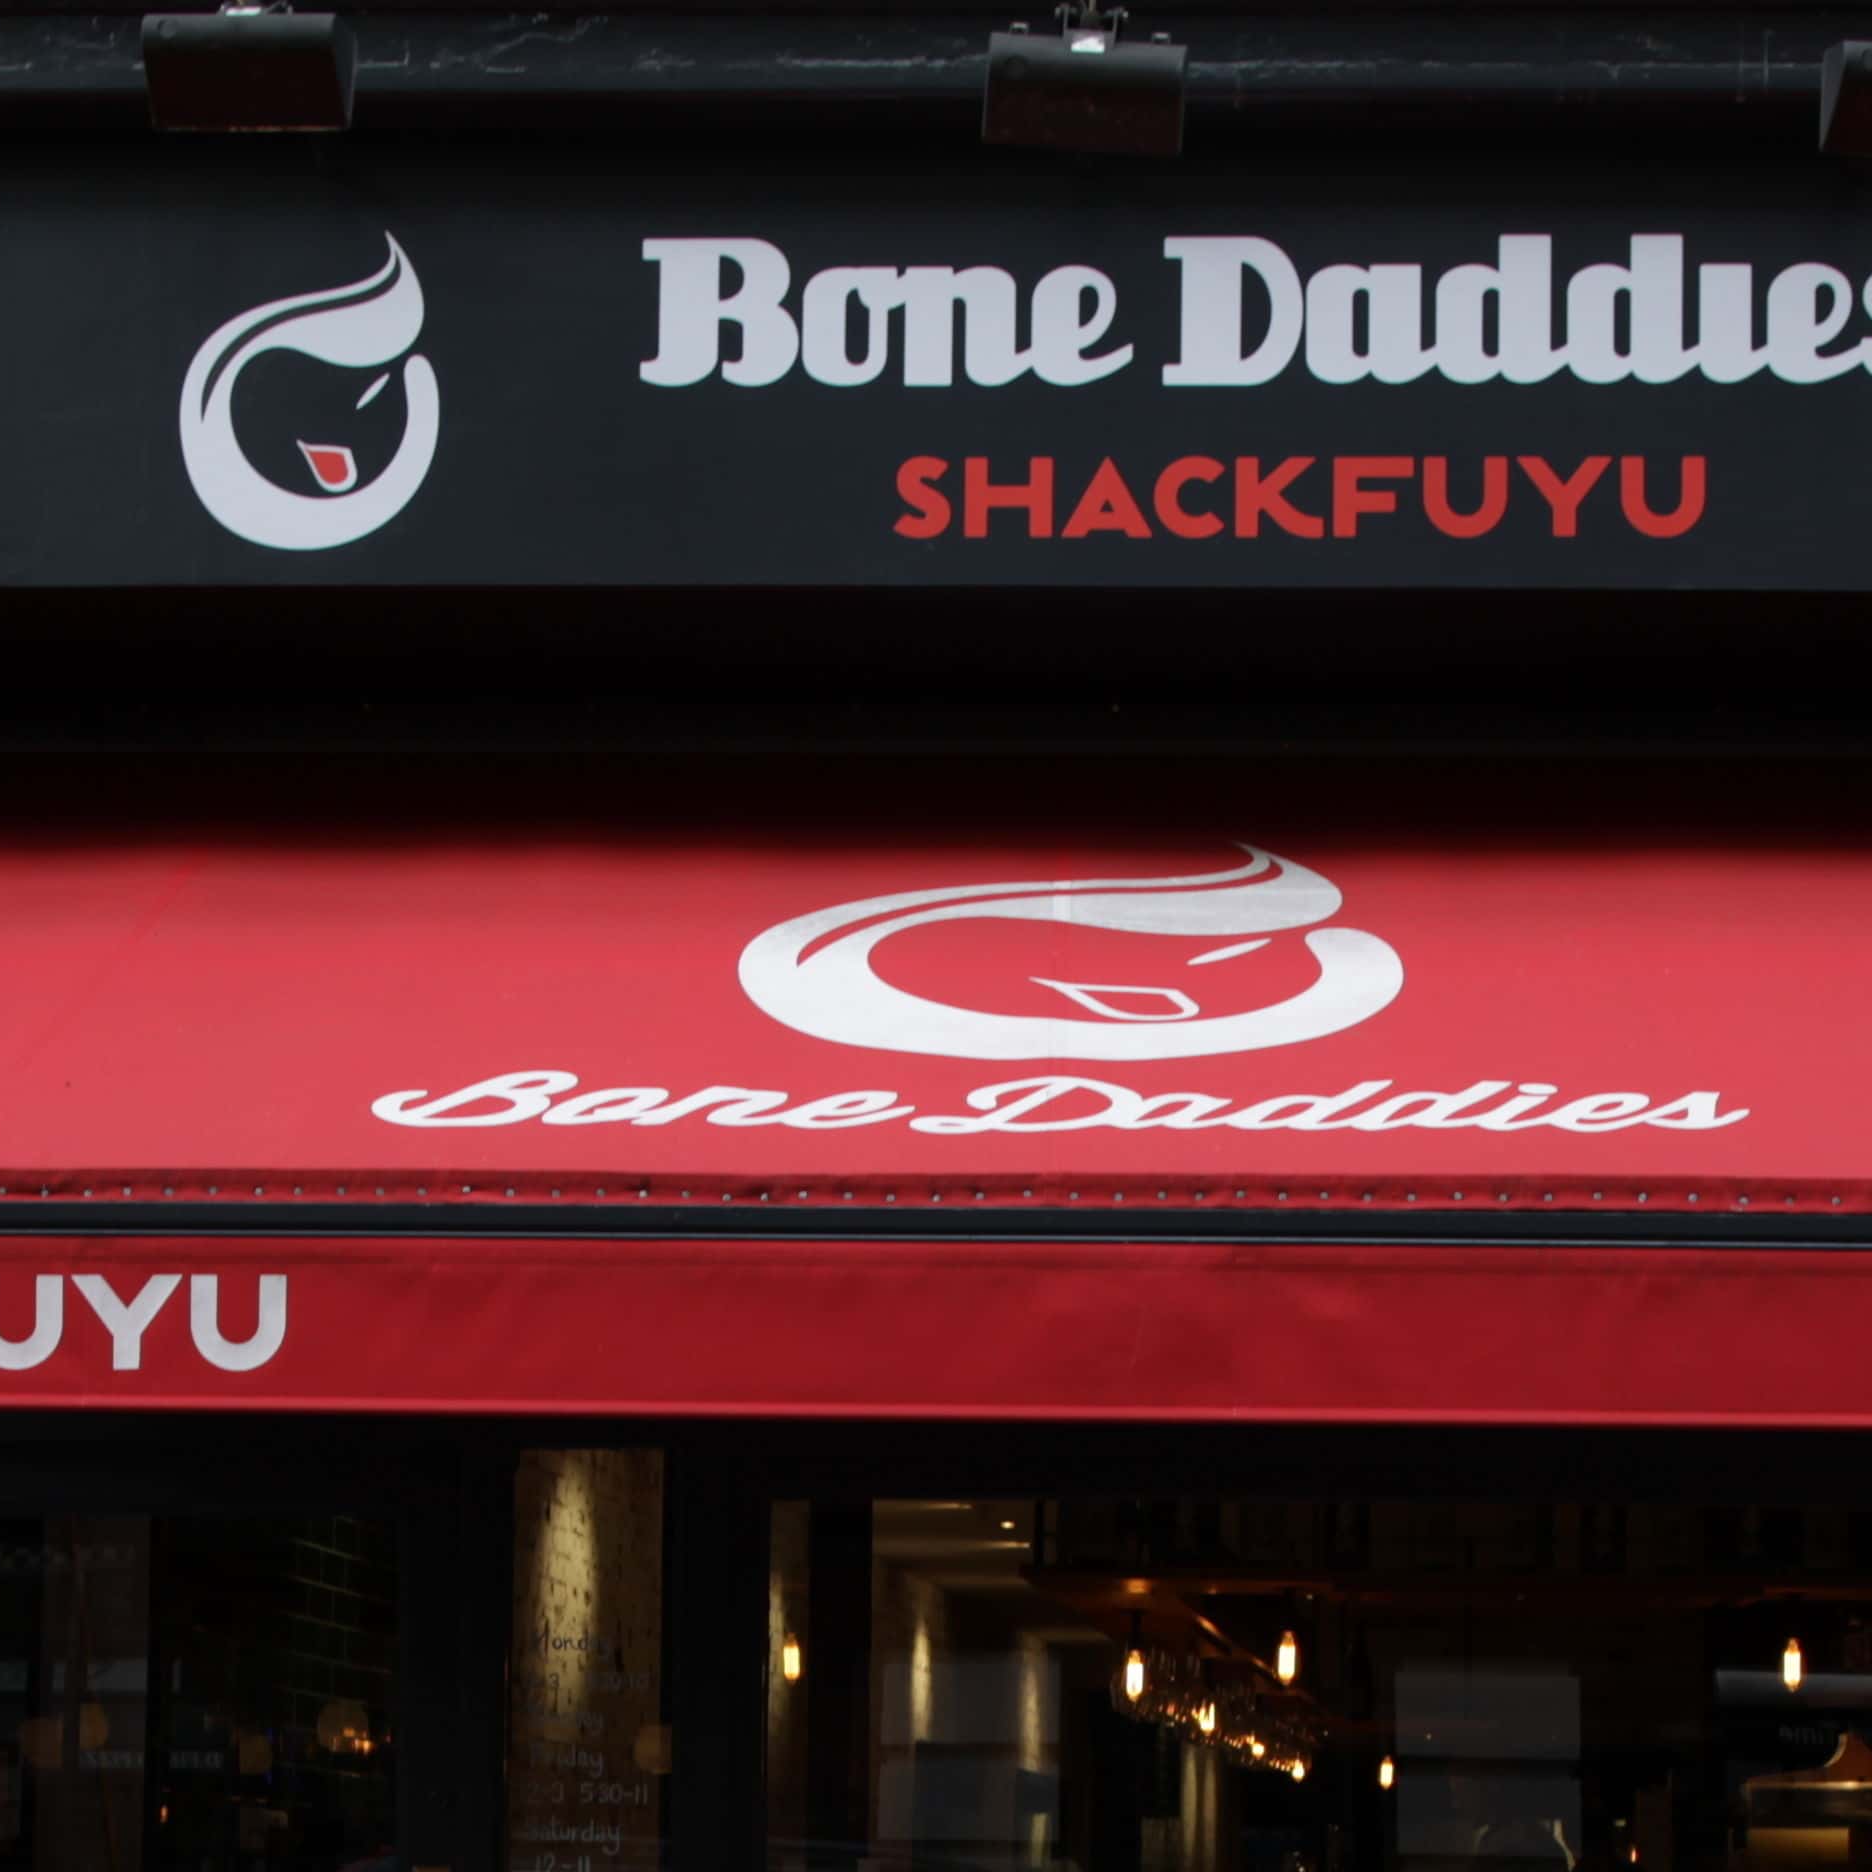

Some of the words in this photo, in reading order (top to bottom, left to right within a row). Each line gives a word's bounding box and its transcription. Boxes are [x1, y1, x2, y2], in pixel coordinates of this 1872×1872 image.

[639, 237, 1134, 388] Bone
[893, 454, 1708, 540] SHACKFUYU
[370, 1070, 915, 1130] Bone
[910, 1075, 1750, 1135] Daddies
